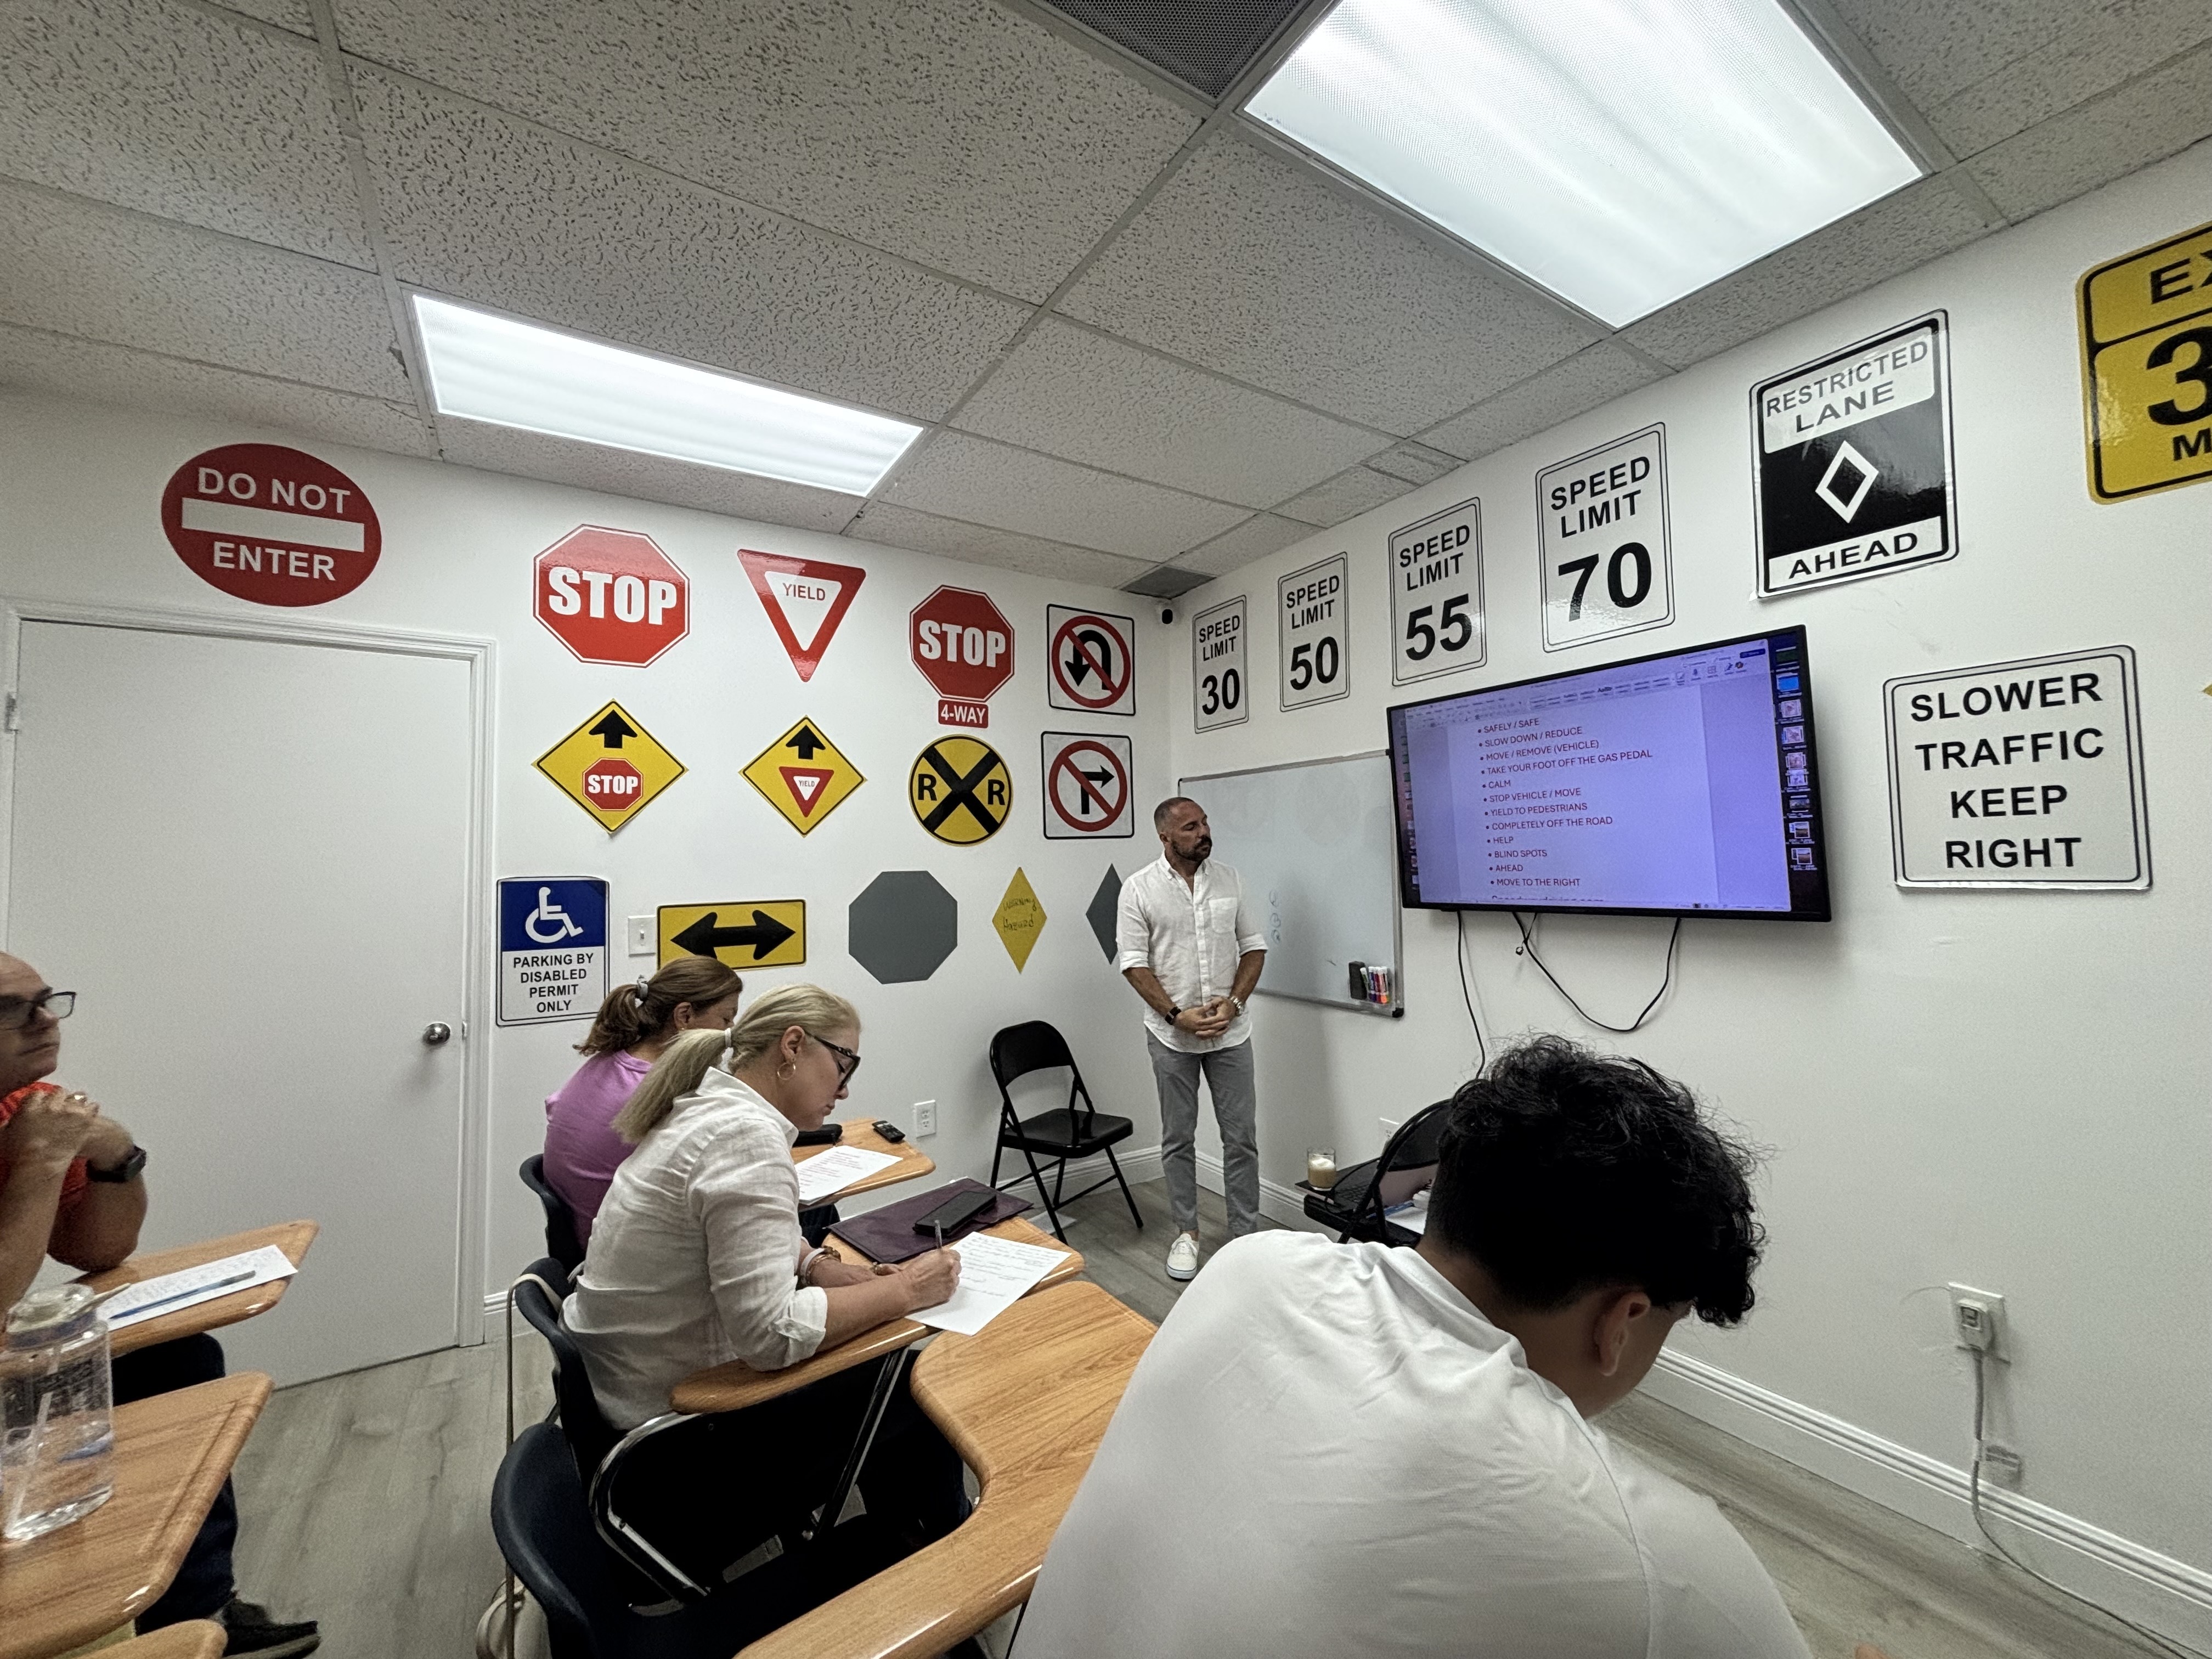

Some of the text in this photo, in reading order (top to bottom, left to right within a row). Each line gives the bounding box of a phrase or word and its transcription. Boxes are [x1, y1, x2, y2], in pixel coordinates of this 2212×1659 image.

[1765, 339, 1928, 418] RESTRICTED
[1796, 377, 1894, 433] LANE
[199, 467, 350, 513] DO NOT
[1550, 455, 1651, 512] SPEED
[1561, 490, 1641, 538] LIMIT
[214, 541, 335, 580] ENTER
[1398, 523, 1471, 568] SPEED
[1788, 532, 1918, 580] AHEAD
[1407, 552, 1463, 591] LIMIT
[1557, 540, 1654, 623] 70
[549, 566, 676, 625] STOP
[783, 583, 825, 601] YIELD
[1285, 574, 1341, 610] SPEED
[1198, 614, 1241, 644] SPEED
[1292, 599, 1334, 629] LIMIT
[1406, 594, 1471, 661] 55
[919, 620, 1005, 667] STOP
[1203, 636, 1236, 661] LIMIT
[1290, 636, 1339, 690] 50
[1203, 669, 1239, 715] 30
[1911, 673, 2102, 721] SLOWER
[941, 704, 985, 724] 4-WAY
[1483, 723, 1512, 733] SAFELY
[1519, 718, 1540, 728] SAFE
[1485, 737, 1509, 747] SLOW
[1510, 733, 1538, 743] DOWN
[1545, 726, 1583, 739] REDUCE
[1487, 752, 1510, 761] MOVE
[1516, 746, 1552, 757] REMOVE
[1554, 740, 1599, 754] (VEHICLE)
[1915, 728, 2104, 770] TRAFFIC
[1487, 749, 1652, 775] TAKE YOUR FOOT OFF THE GAS PEDAL
[588, 775, 638, 794] STOP
[798, 780, 815, 788] YIELD
[1488, 780, 1511, 788] CALM
[1489, 794, 1511, 803] STOP
[1511, 791, 1547, 801] VEHICLE
[1555, 788, 1581, 797] MOVE
[1491, 808, 1513, 816] YIELD
[1528, 803, 1588, 814] PEDESTRIANS
[1951, 785, 2067, 818] KEEP
[1492, 816, 1612, 831] COMPLETELY OFF THE ROAD
[1520, 849, 1547, 857] SPOTS
[1946, 838, 2081, 868] RIGHT
[514, 953, 593, 968] PARKING BY
[521, 969, 586, 983] DISABLED
[530, 984, 578, 998] PERMIT
[537, 1000, 571, 1013] ONLY
